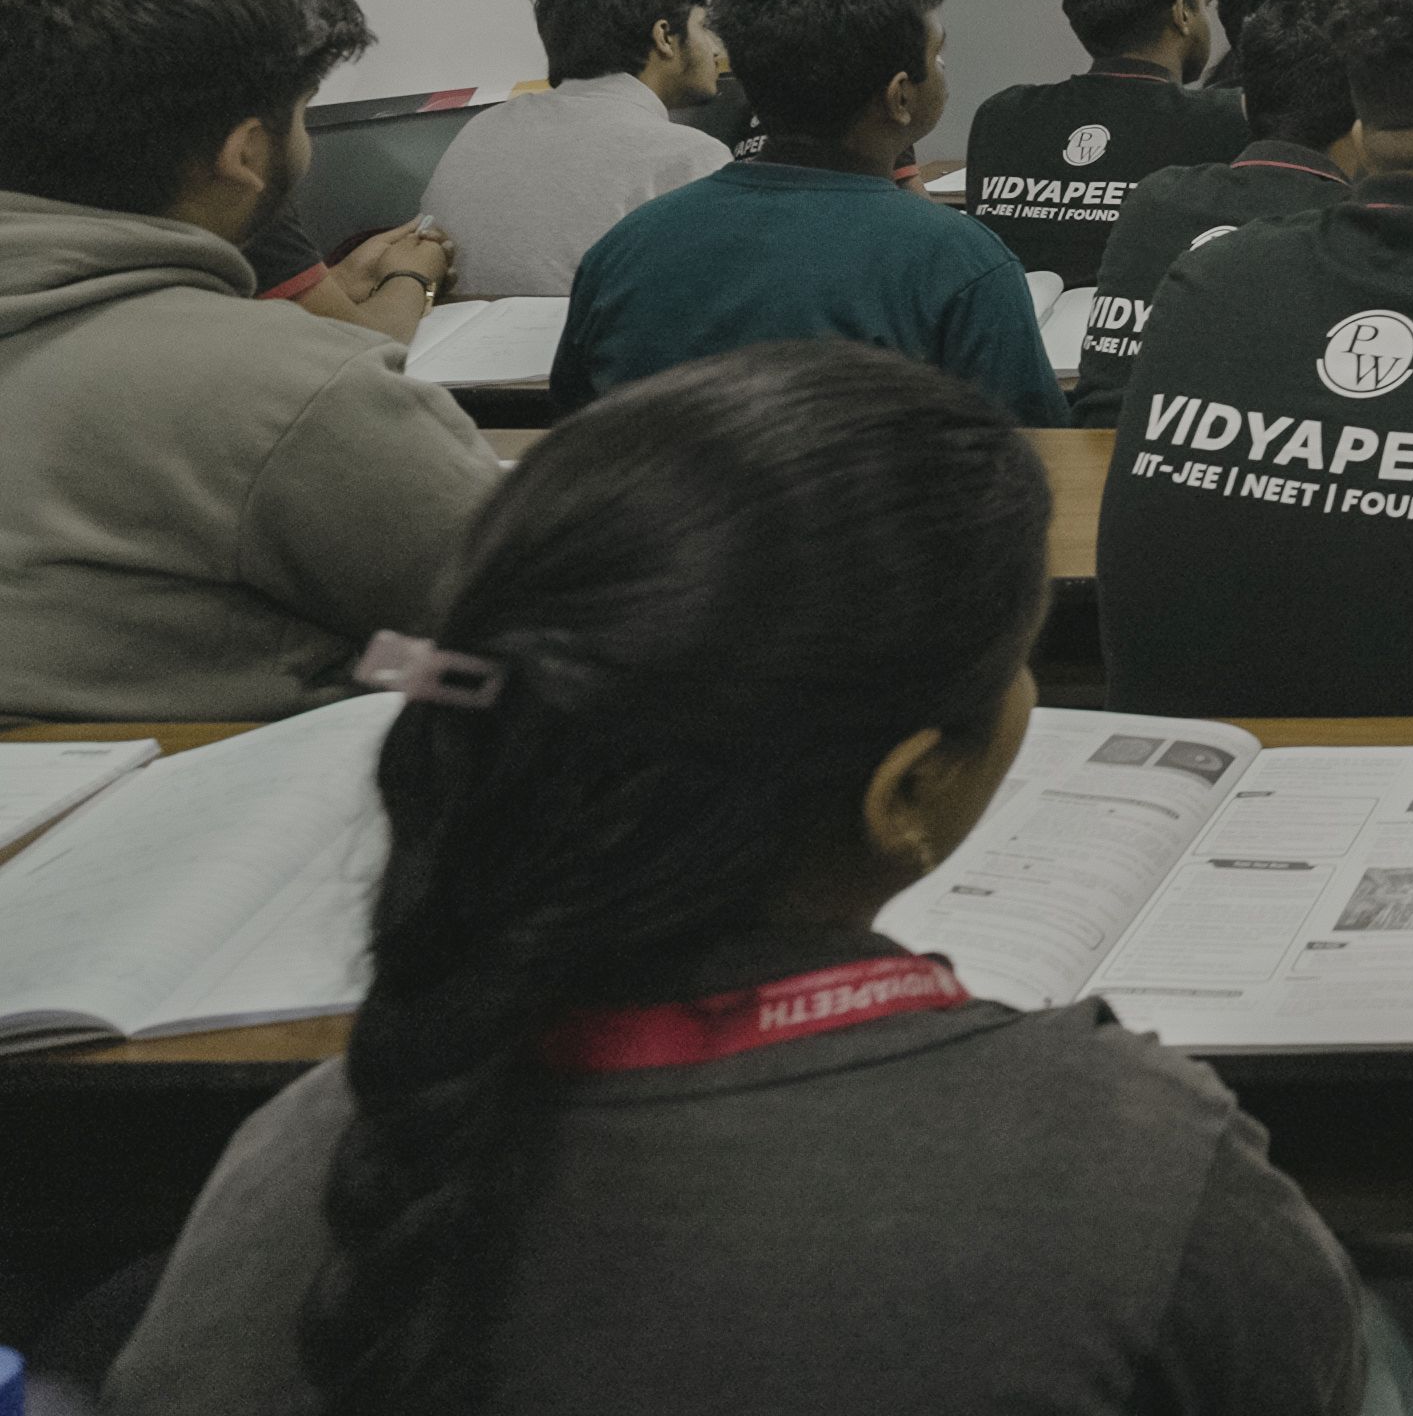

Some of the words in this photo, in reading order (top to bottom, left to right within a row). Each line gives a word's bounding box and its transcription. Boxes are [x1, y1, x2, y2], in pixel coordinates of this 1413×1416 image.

[1022, 206, 1059, 220] NEET
[1131, 451, 1224, 489] IIT-JEE
[1240, 471, 1320, 508] NEET
